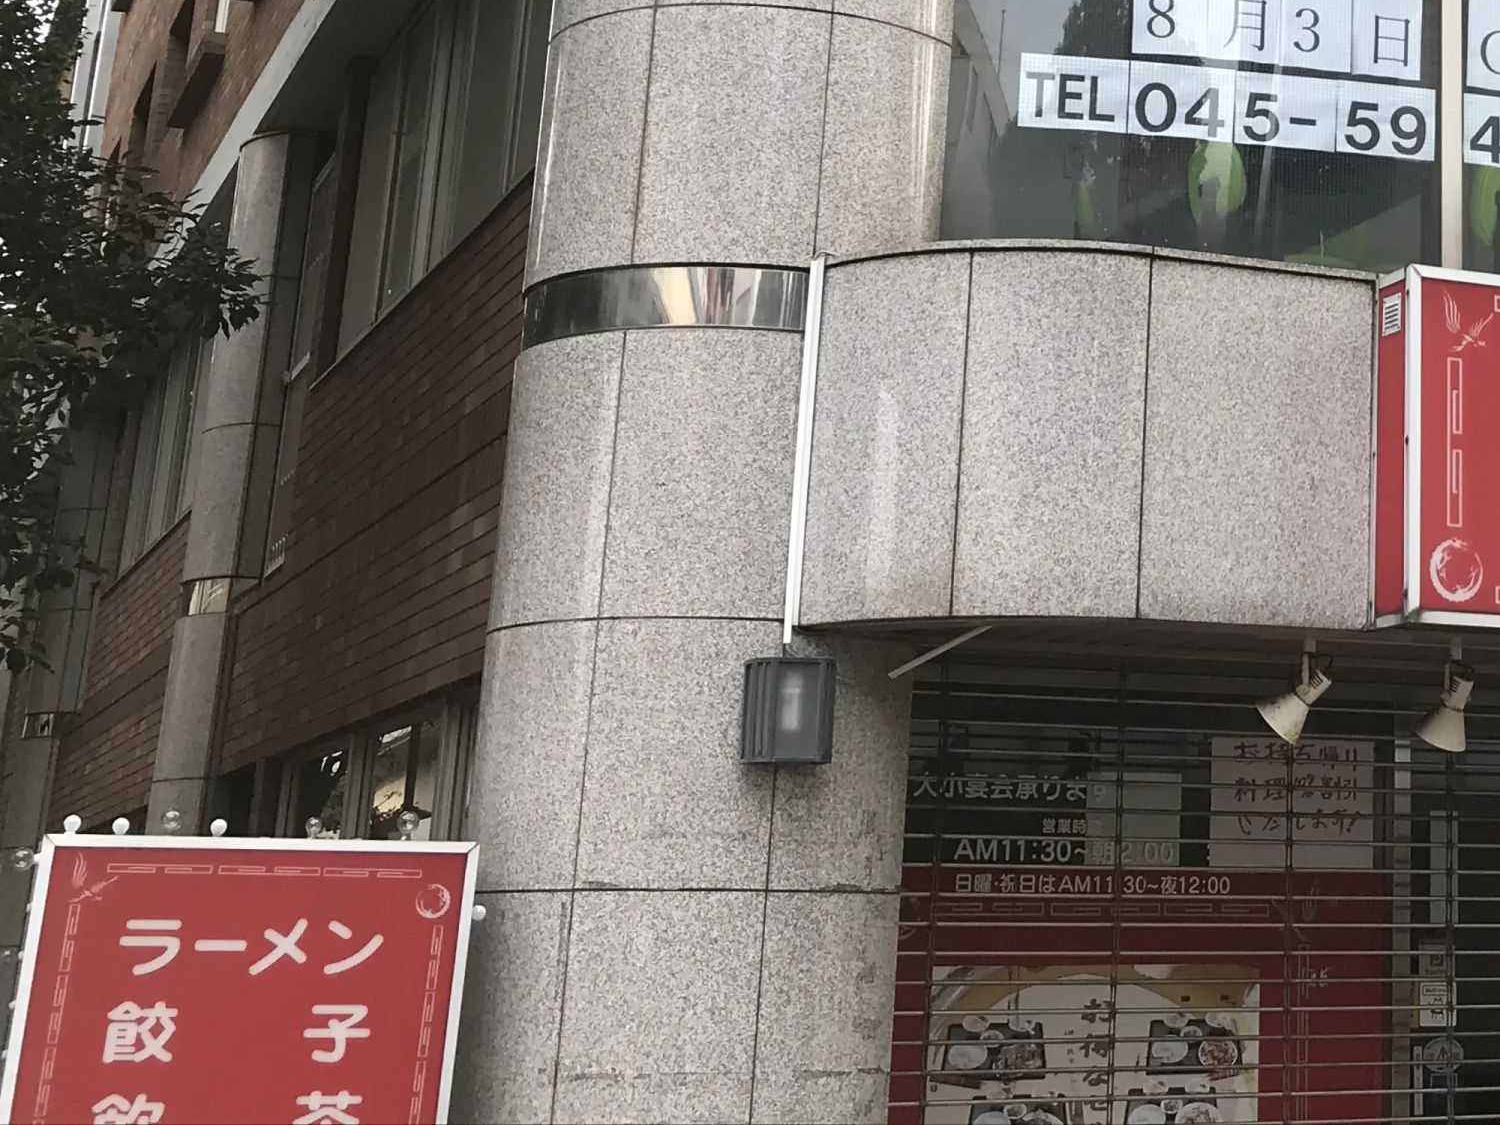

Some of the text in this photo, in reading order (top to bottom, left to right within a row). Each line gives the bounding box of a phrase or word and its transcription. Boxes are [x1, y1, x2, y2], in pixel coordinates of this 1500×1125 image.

[1025, 71, 1115, 122] TEL
[118, 918, 385, 976] ラーメン
